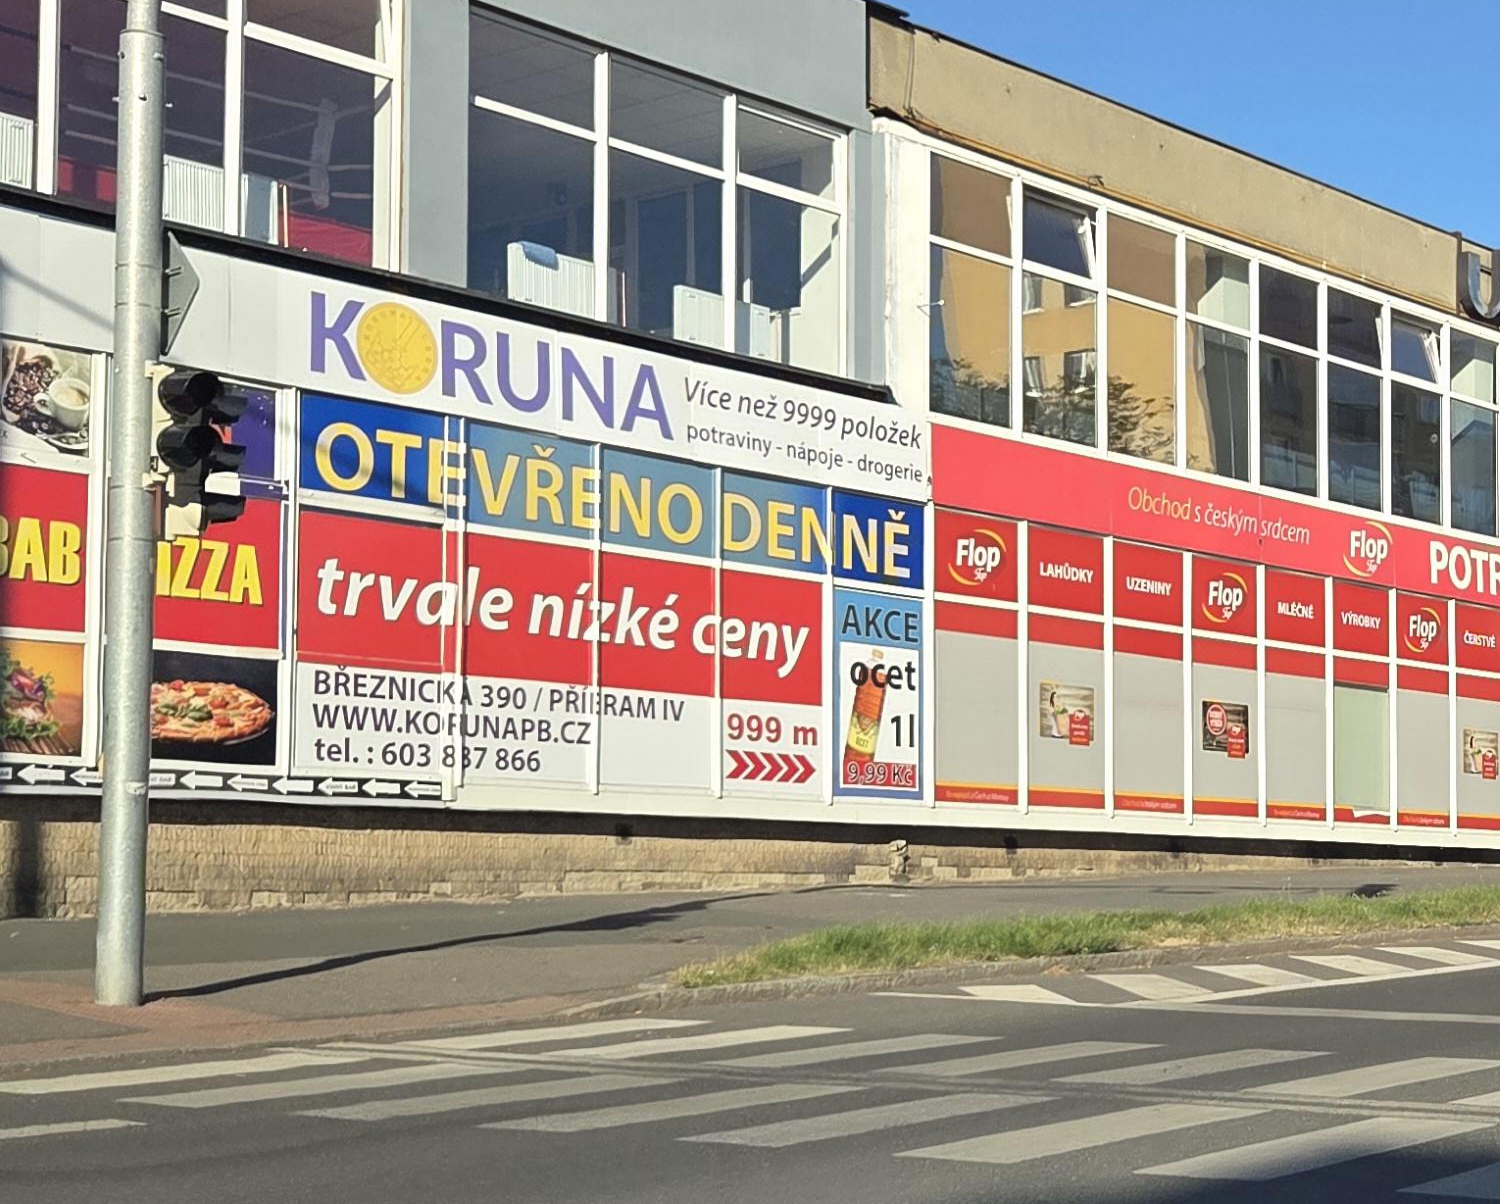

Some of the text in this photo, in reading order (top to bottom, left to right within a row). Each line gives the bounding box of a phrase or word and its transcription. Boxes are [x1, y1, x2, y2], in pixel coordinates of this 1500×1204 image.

[311, 291, 674, 441] KORUNA
[684, 376, 923, 450] Více než 9999 položek
[687, 424, 772, 458] potraviny
[787, 441, 844, 470] nápoje
[857, 454, 923, 483] drogerie
[315, 421, 911, 579] OTEVŘENO DENNĚ
[1128, 486, 1310, 544] Obchod s českým srdcem
[0, 516, 81, 586] AB
[956, 538, 1001, 573] Flop
[1350, 530, 1388, 565] Flop
[155, 536, 263, 605] IZZA
[1039, 561, 1094, 584] LAHŮDKY
[1126, 576, 1172, 596] UZENINY
[1208, 580, 1243, 612] Flop
[317, 557, 810, 679] trvale nízké ceny
[841, 603, 920, 644] AKCE
[1277, 600, 1381, 629] MLÉČNÉ VÝROBKY
[1409, 614, 1437, 641] Flop
[1463, 629, 1496, 648] ČERSTVÉ
[313, 664, 473, 706] BŘEZNICKÁ
[480, 683, 527, 710] 390
[662, 698, 685, 722] IV
[849, 660, 917, 692] ocet
[727, 713, 818, 746] 999 m
[381, 742, 431, 768] 603
[442, 744, 488, 770] 887
[495, 748, 541, 772] 866
[847, 761, 914, 786] 9,99 Kč
